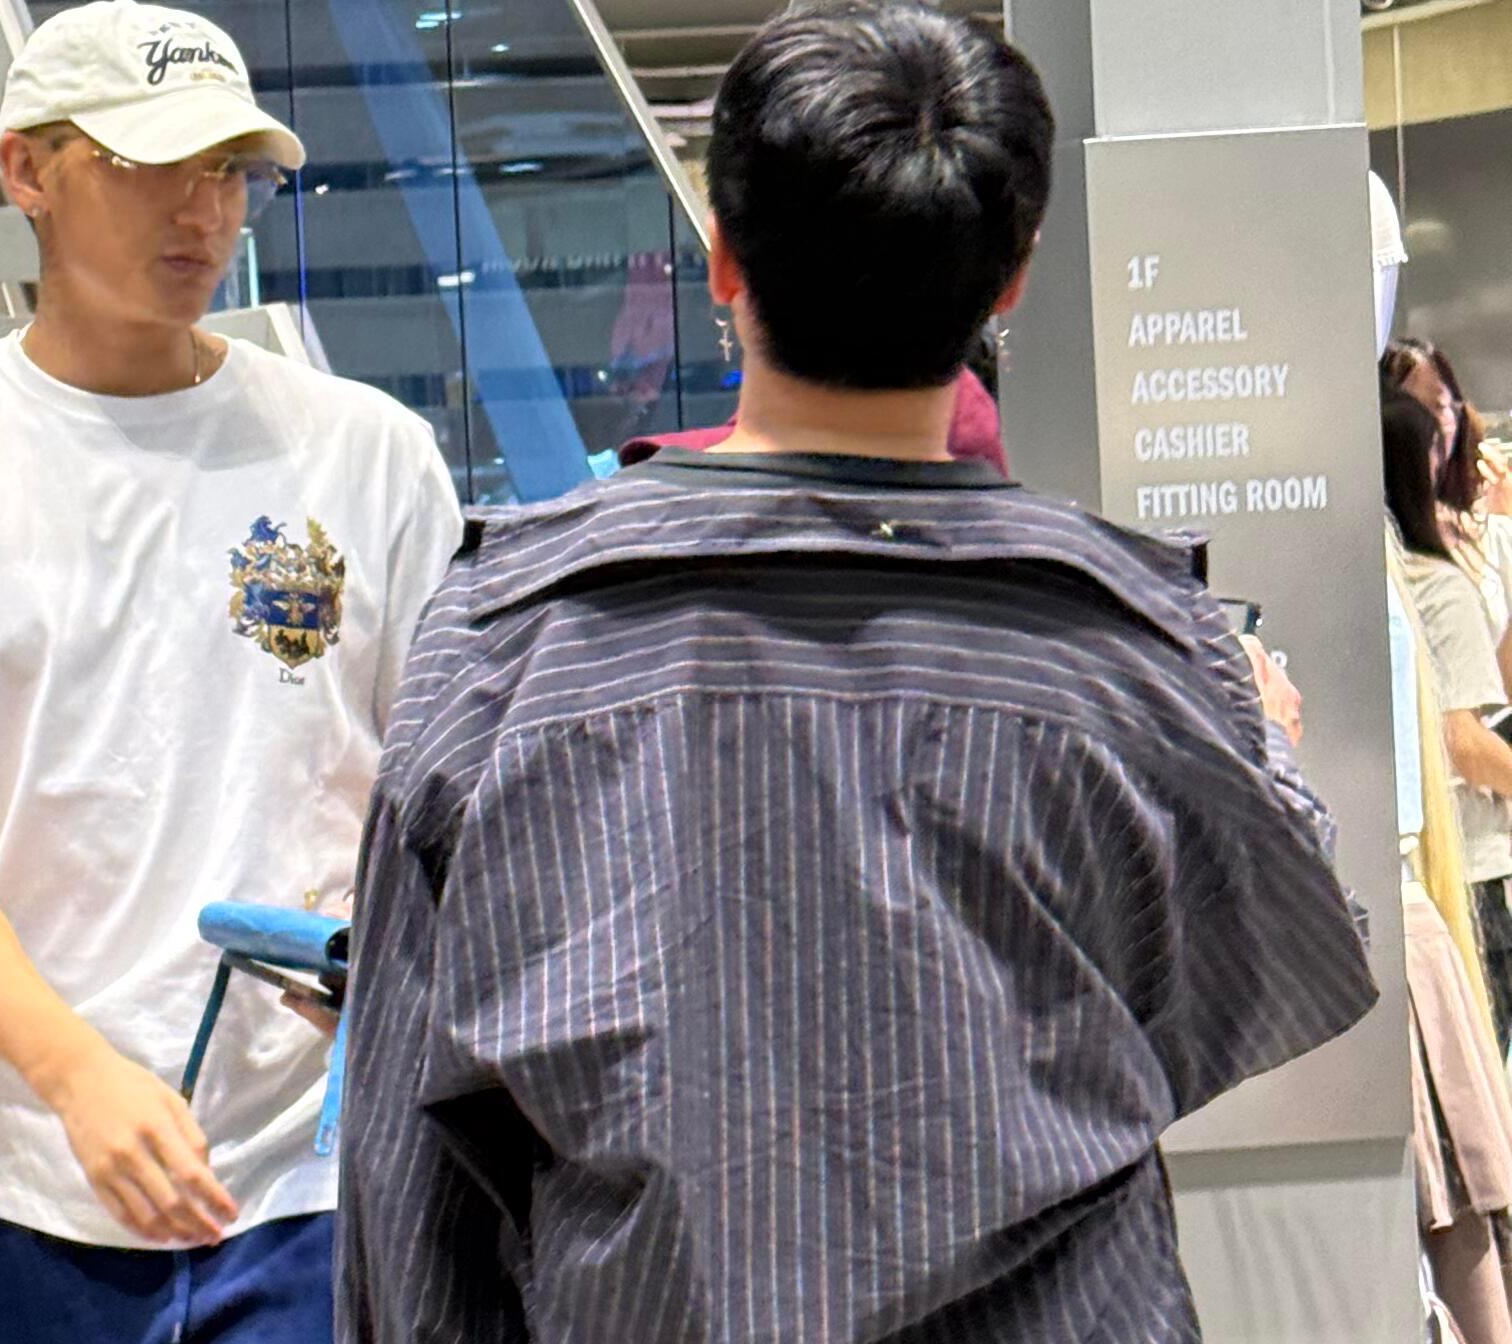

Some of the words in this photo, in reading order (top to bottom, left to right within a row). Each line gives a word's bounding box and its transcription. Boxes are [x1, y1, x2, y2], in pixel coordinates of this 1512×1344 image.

[1127, 256, 1159, 288] 1F
[1128, 308, 1248, 347] APPAREL
[1132, 363, 1289, 404] ACCESSORY
[1135, 422, 1250, 462] CASHIER
[1137, 480, 1238, 519] FITTING
[1246, 475, 1328, 512] ROOM
